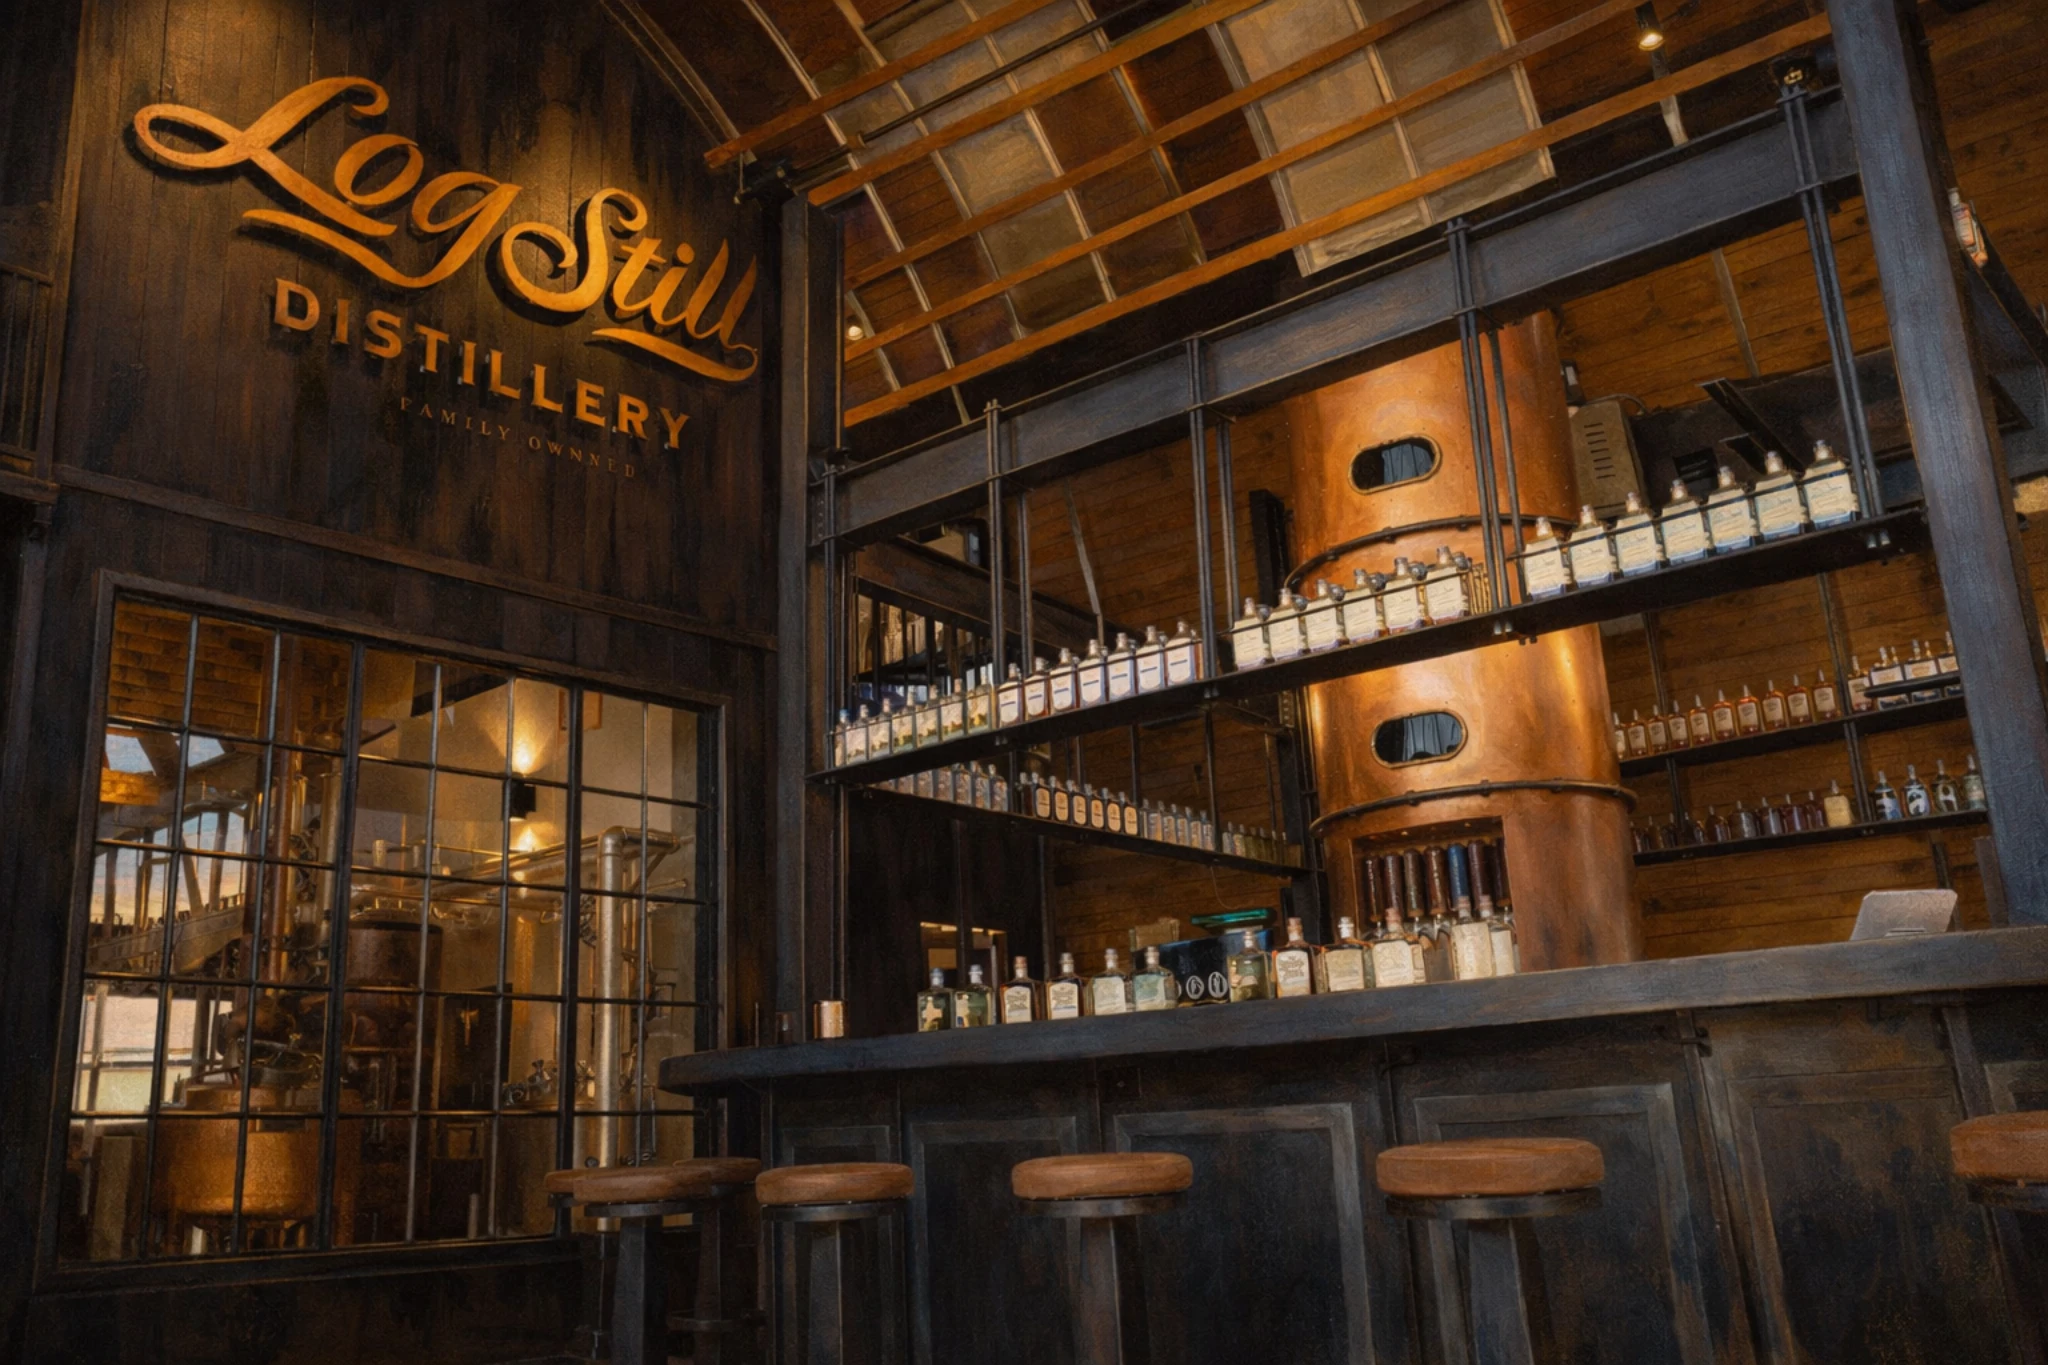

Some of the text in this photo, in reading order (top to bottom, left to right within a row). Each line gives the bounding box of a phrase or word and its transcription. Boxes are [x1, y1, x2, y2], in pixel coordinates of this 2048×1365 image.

[134, 76, 758, 382] Log Still
[273, 278, 690, 450] DISTILLERY
[400, 397, 510, 441] FAMILY
